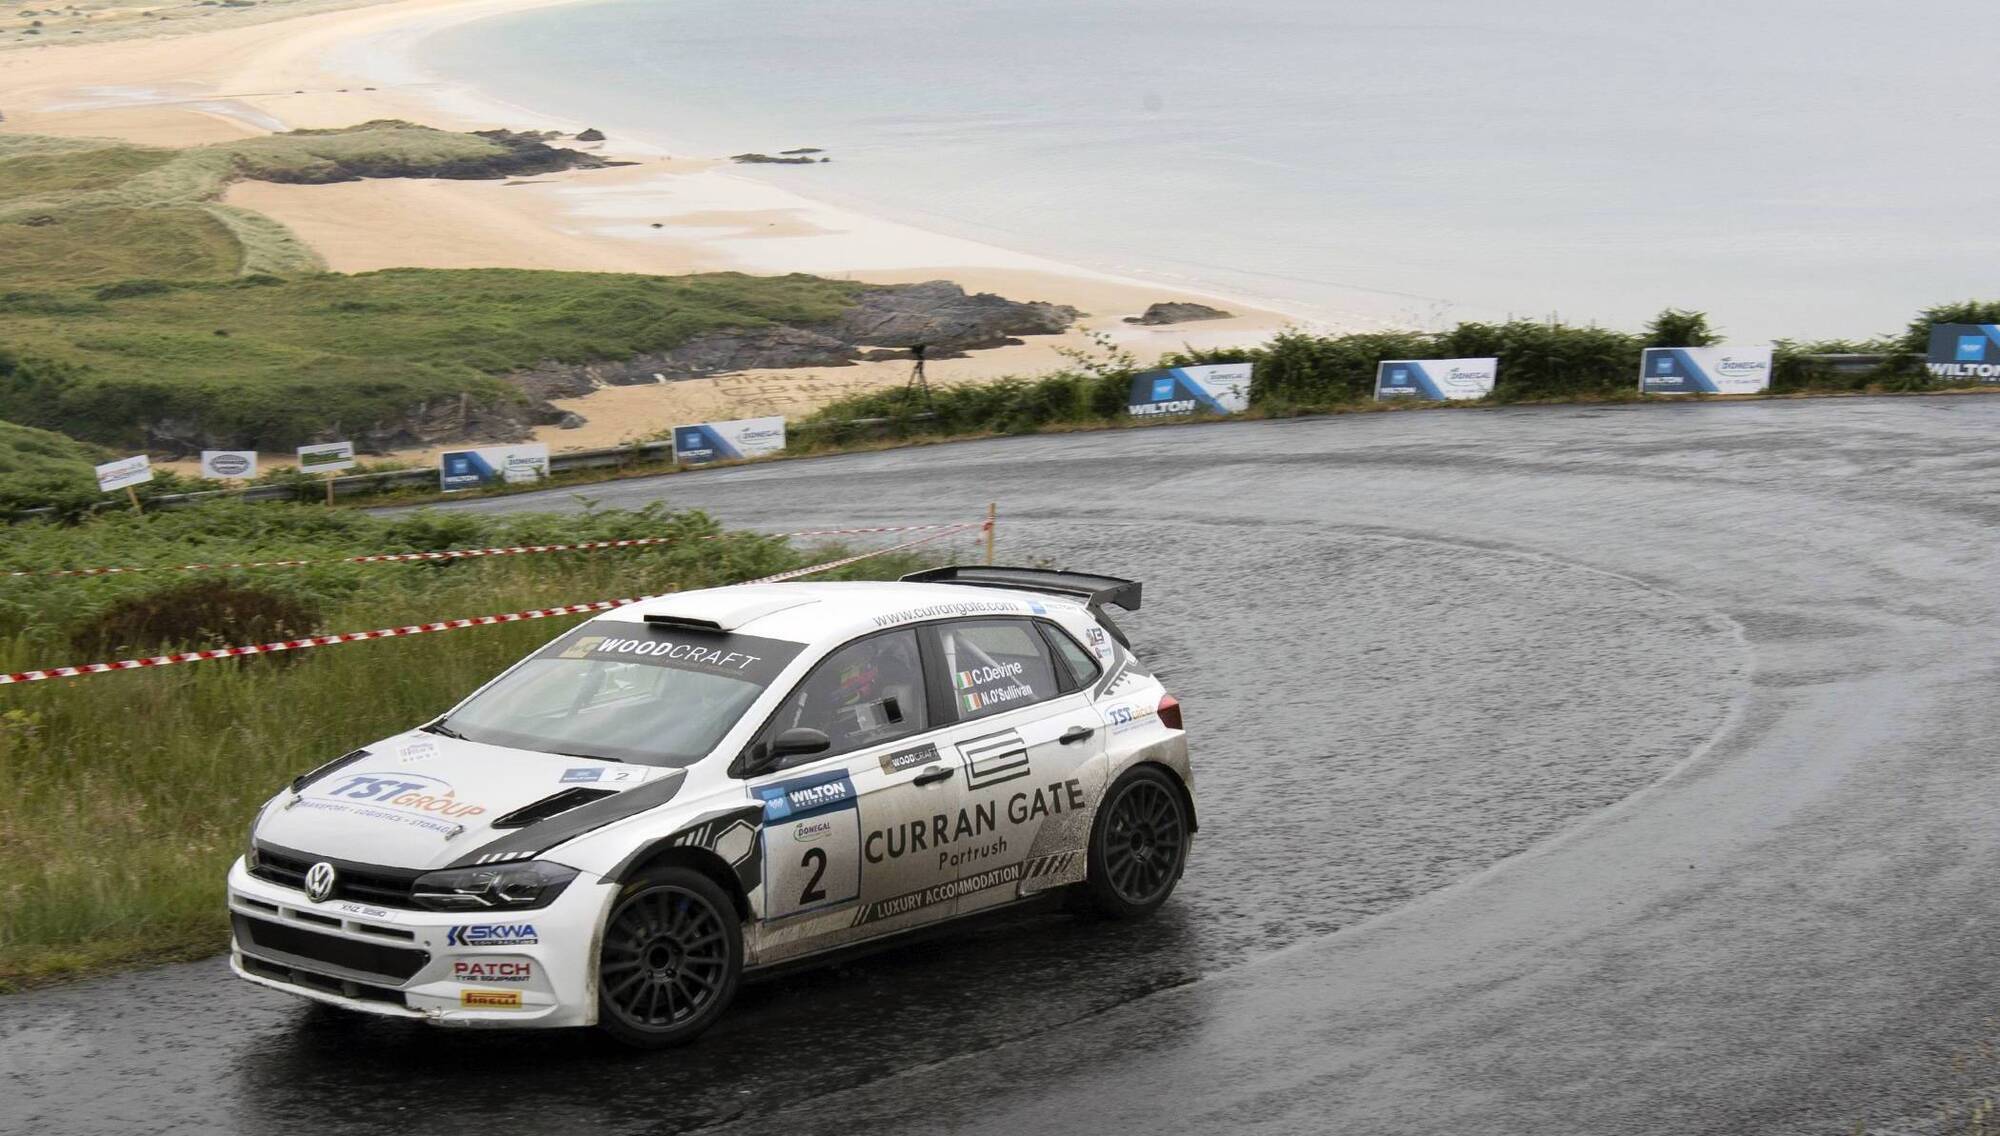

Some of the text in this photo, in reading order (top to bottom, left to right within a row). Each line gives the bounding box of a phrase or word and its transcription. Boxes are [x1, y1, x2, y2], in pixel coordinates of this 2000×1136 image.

[1128, 400, 1195, 415] WILTON
[873, 600, 1020, 627] www.currangate.com
[598, 638, 761, 669] WOODCRAFT
[972, 661, 1023, 685] C.Devine
[789, 782, 846, 803] WILTON
[798, 821, 831, 837] DONEGAL
[864, 778, 1086, 864] CURRAN GATE
[800, 848, 827, 905] 2
[878, 866, 1020, 919] LUXURY ACCOMMODATION
[467, 924, 538, 939] SKWA
[454, 962, 531, 976] PATCH
[466, 992, 517, 1006] PIRELLI
